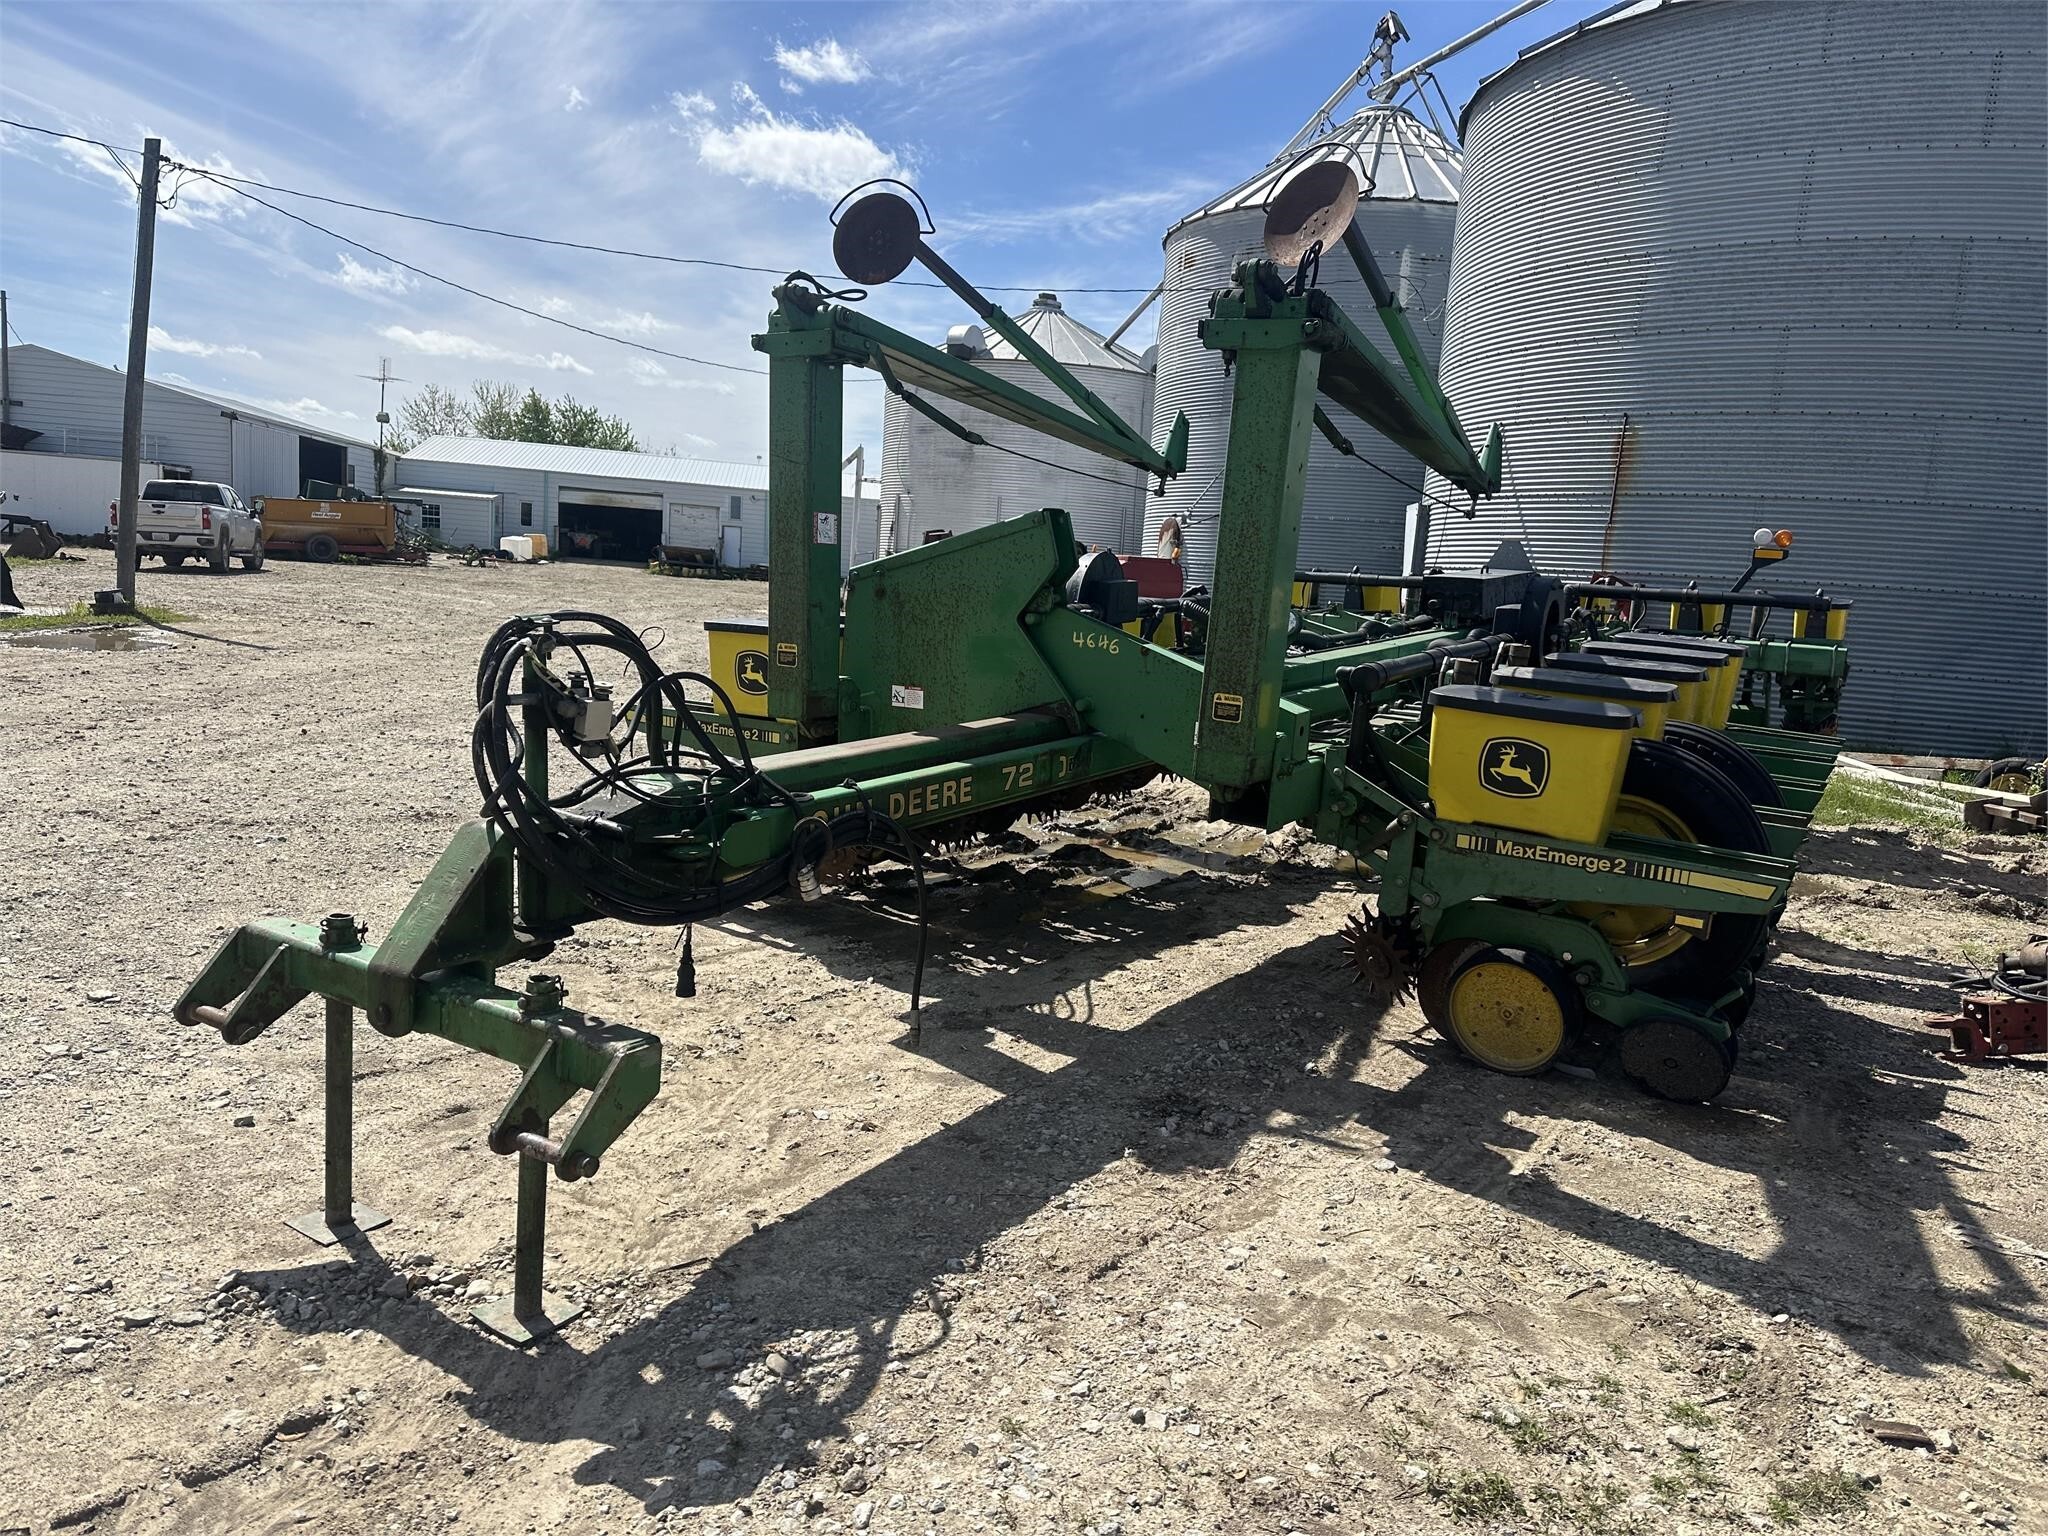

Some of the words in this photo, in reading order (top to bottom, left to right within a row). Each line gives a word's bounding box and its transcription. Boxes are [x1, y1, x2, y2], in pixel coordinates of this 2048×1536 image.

[1072, 631, 1120, 654] 4646
[751, 728, 759, 741] 2
[889, 776, 973, 821] DEERE
[1495, 839, 1611, 873] MaxEmerge
[1613, 858, 1627, 874] 2
